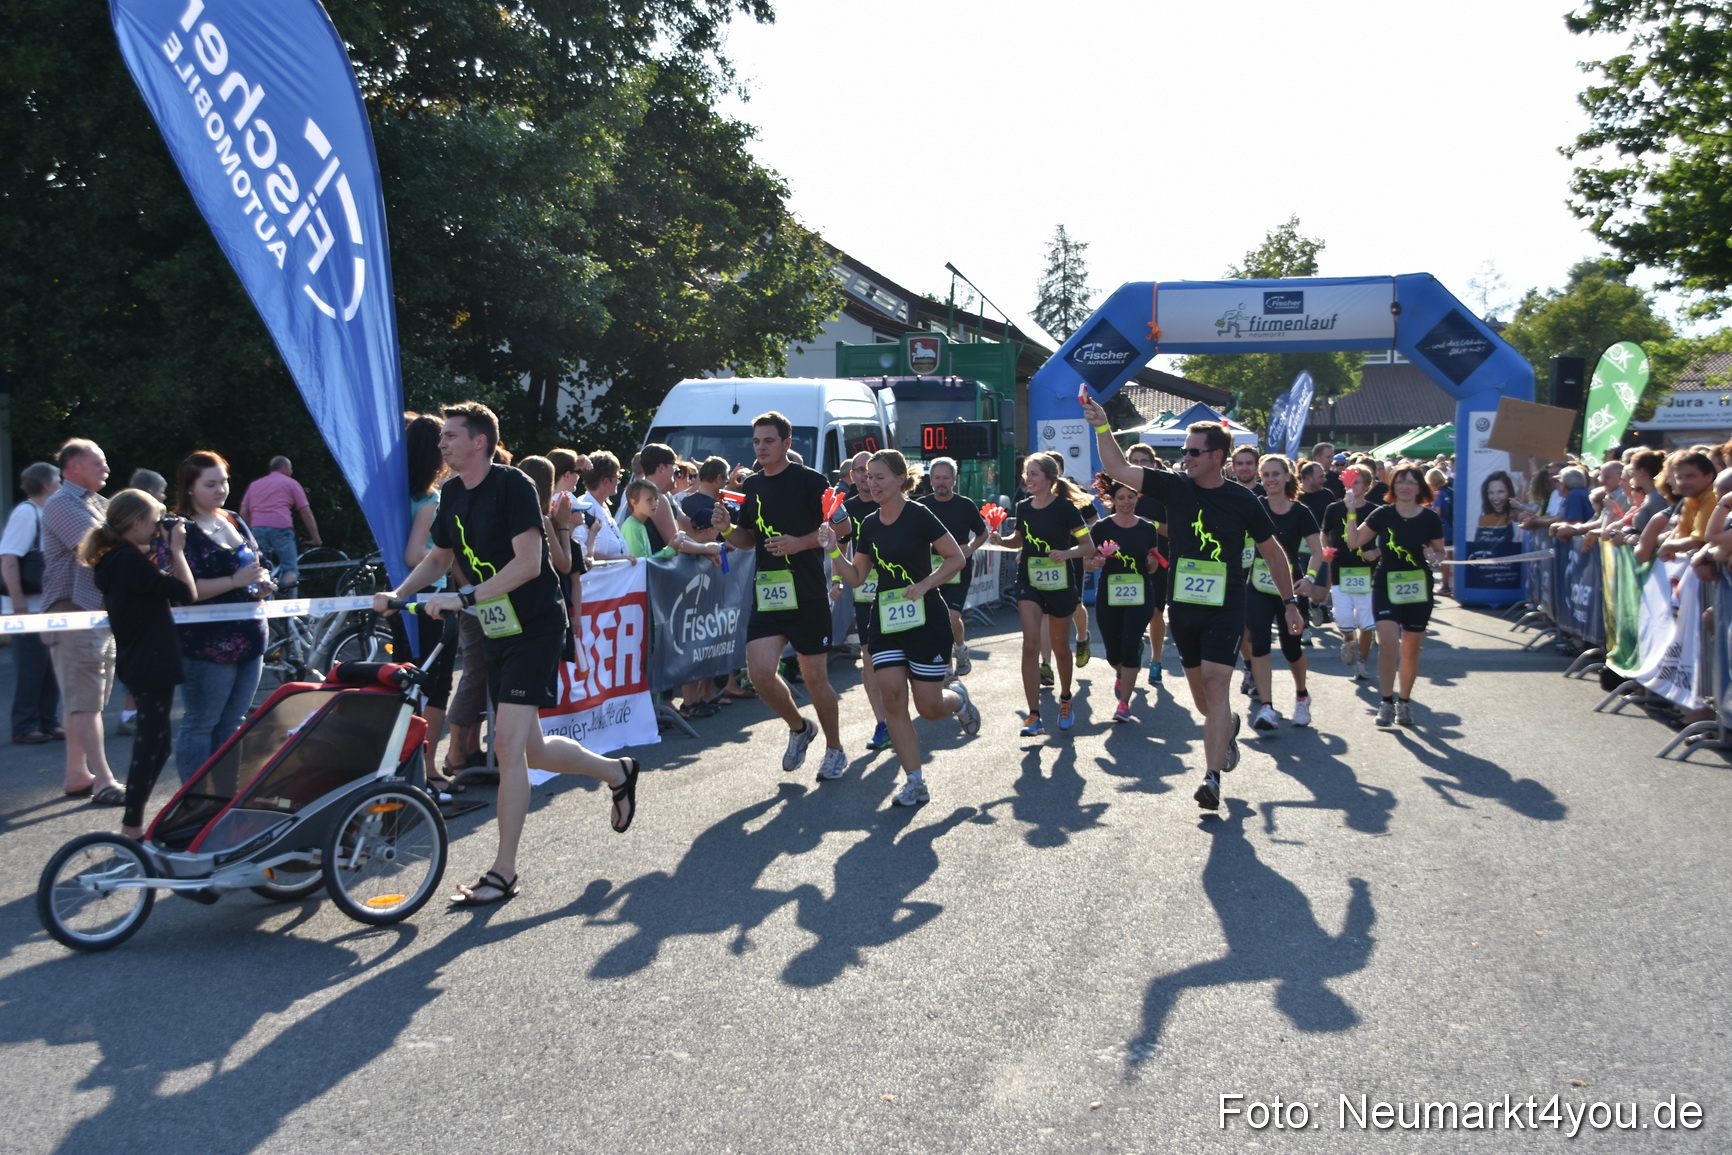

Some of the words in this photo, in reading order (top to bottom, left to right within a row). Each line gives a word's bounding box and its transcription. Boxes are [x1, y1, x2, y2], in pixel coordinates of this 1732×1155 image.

[1271, 299, 1302, 307] Fischer
[1249, 313, 1338, 332] firmenlauf
[1083, 350, 1130, 360] Fischer
[1613, 382, 1639, 411] AOK
[1667, 397, 1704, 407] Jura
[1587, 404, 1616, 438] AOK
[1035, 570, 1060, 582] 218
[1345, 577, 1365, 587] 236
[1115, 586, 1137, 597] 223
[1184, 576, 1215, 592] 227
[1395, 583, 1419, 595] 225
[762, 586, 788, 600] 245
[480, 606, 506, 625] 243
[888, 603, 916, 621] 219
[682, 603, 741, 643] Fischer
[692, 640, 736, 663] AUTOMOBILE
